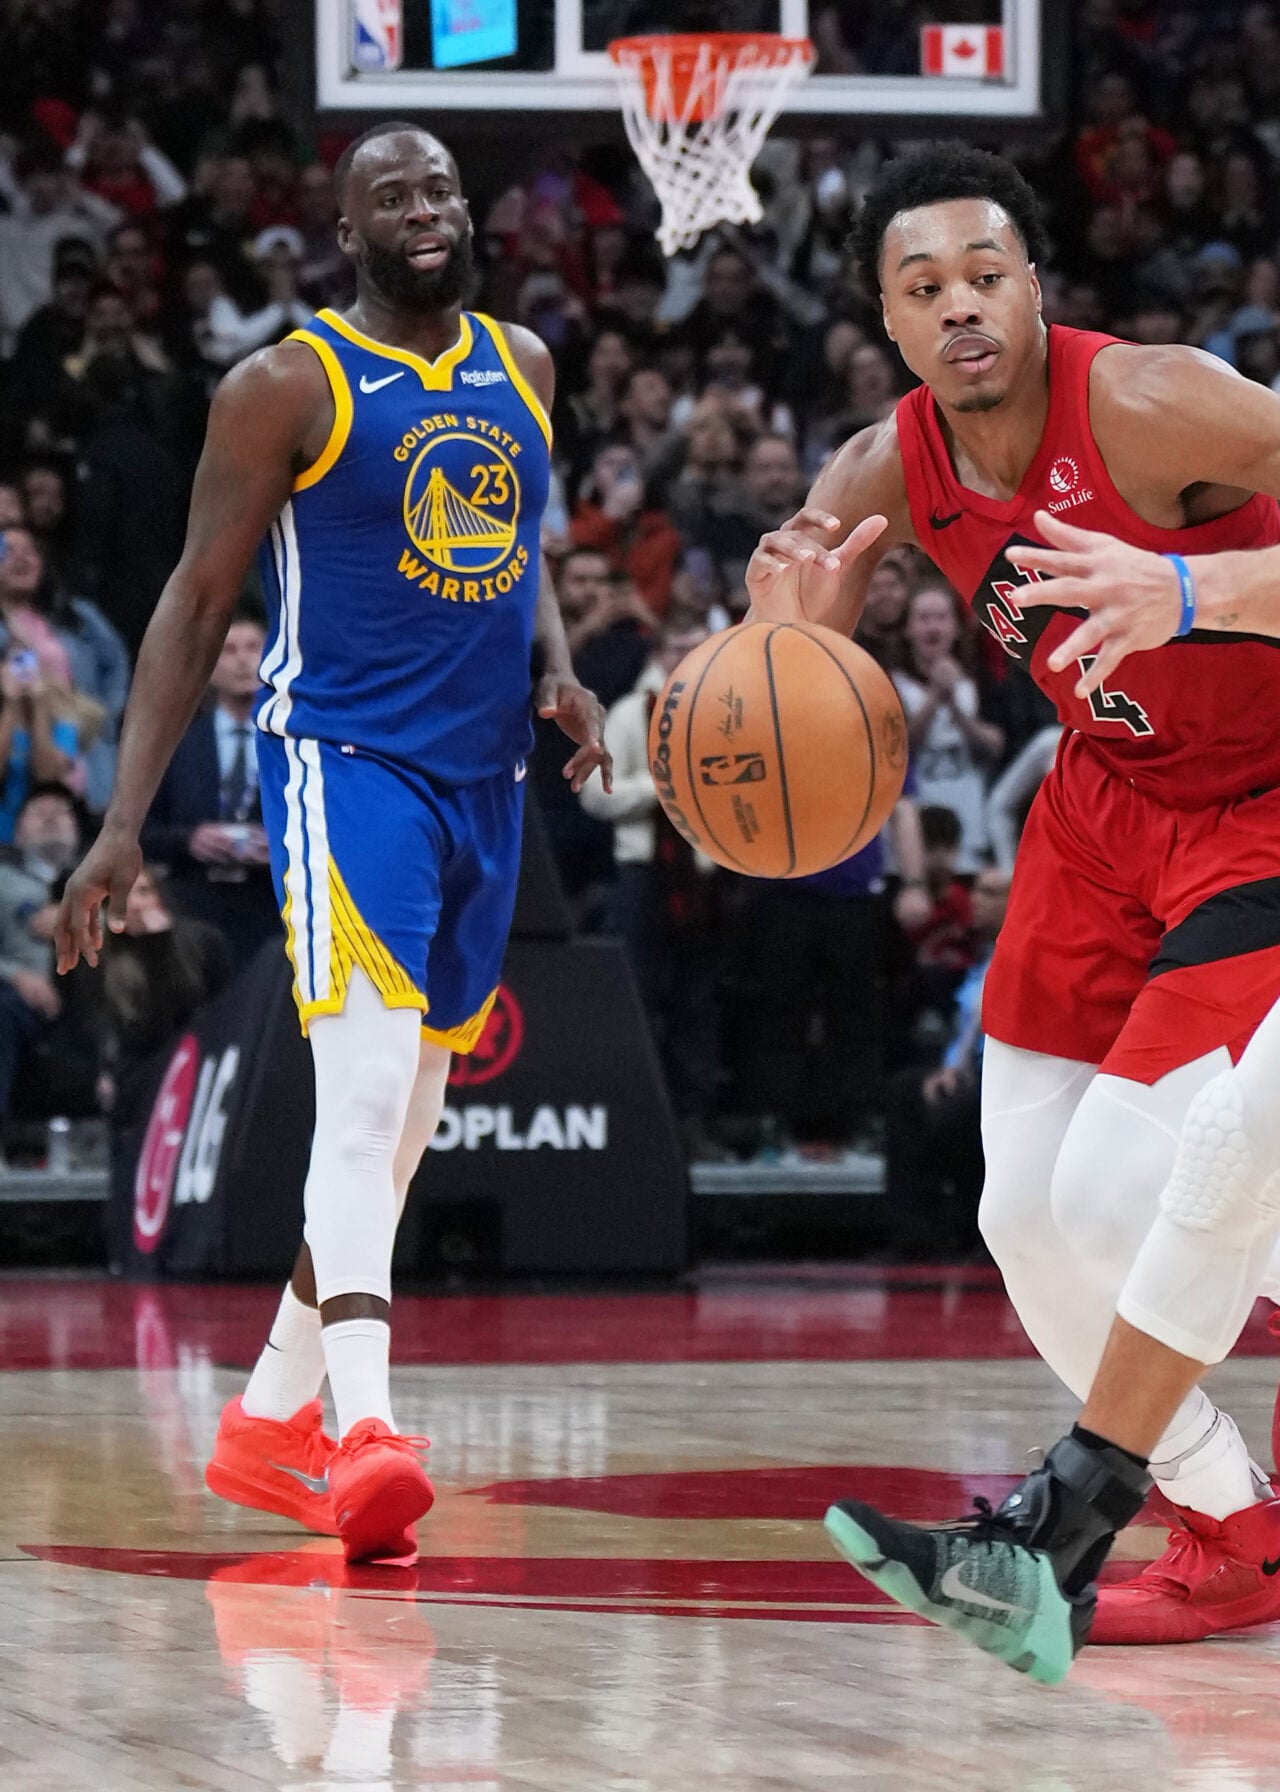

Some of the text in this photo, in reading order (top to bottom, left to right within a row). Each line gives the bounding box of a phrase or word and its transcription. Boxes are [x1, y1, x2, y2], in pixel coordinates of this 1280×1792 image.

[460, 371, 507, 386] Rakuten
[393, 413, 522, 462] GOLDEN STATE
[470, 464, 510, 505] 23
[1048, 488, 1095, 514] Sun Life
[397, 545, 530, 602] WARRIORS
[1077, 654, 1155, 737] 4
[428, 1104, 608, 1151] OPLAN
